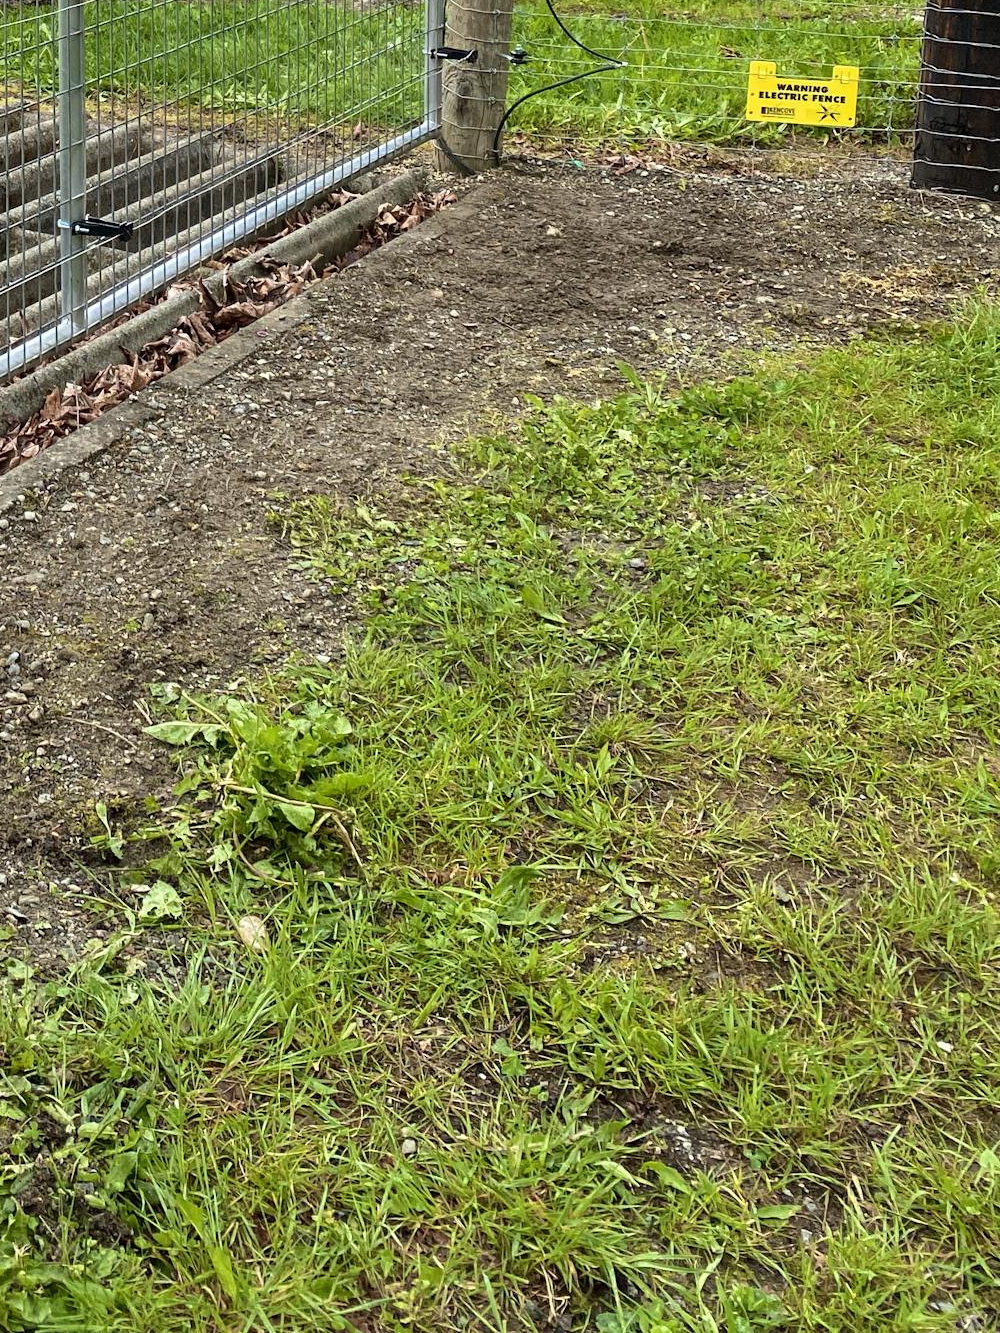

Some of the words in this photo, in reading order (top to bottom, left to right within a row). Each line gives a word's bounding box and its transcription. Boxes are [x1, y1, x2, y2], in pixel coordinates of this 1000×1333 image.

[777, 83, 829, 93] WARNING
[759, 92, 808, 101] ELECTRIC
[812, 94, 846, 103] FENCE
